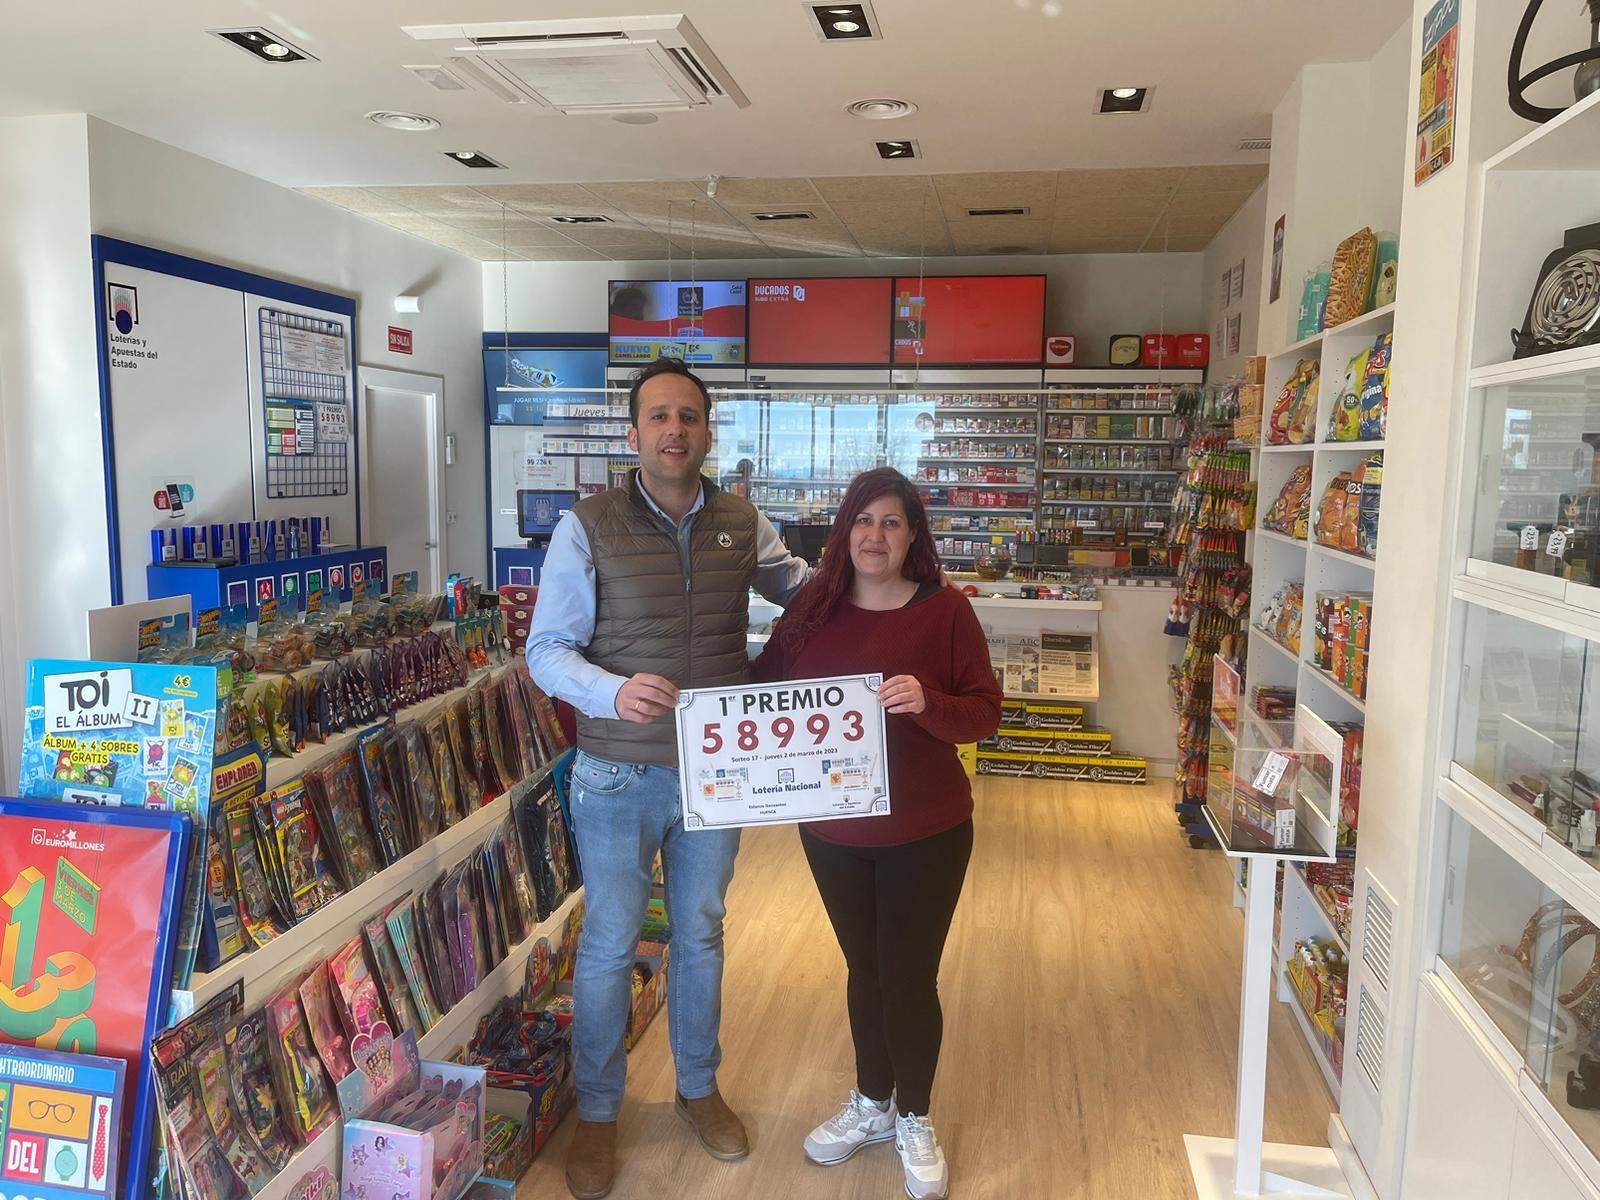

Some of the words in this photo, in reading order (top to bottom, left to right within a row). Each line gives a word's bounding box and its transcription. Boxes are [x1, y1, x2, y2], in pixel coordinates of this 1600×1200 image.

[754, 285, 789, 295] DUCADOS
[141, 339, 147, 347] y
[615, 345, 651, 353] NUEVO
[111, 346, 146, 357] Apuestas
[146, 350, 158, 359] del
[112, 358, 138, 369] Estado
[573, 407, 606, 417] Jueves
[1020, 638, 1040, 647] ABC
[742, 686, 845, 715] PREMIO
[56, 717, 70, 728] EL
[76, 710, 121, 727] ÁLBUM
[702, 710, 865, 754] 58993
[43, 734, 77, 749] ÁLBUM
[90, 741, 96, 750] 4
[101, 741, 139, 754] SOBRES
[71, 752, 108, 764] GRATIS
[764, 753, 783, 761] jueves
[215, 761, 259, 790] EXPLORER
[785, 781, 821, 792] Nacional
[45, 838, 105, 851] EUROMILLONES
[57, 879, 63, 889] 3
[63, 886, 76, 900] DE
[59, 870, 95, 906] VIERNES
[57, 891, 87, 924] MARZO
[7, 1139, 39, 1174] DEL
